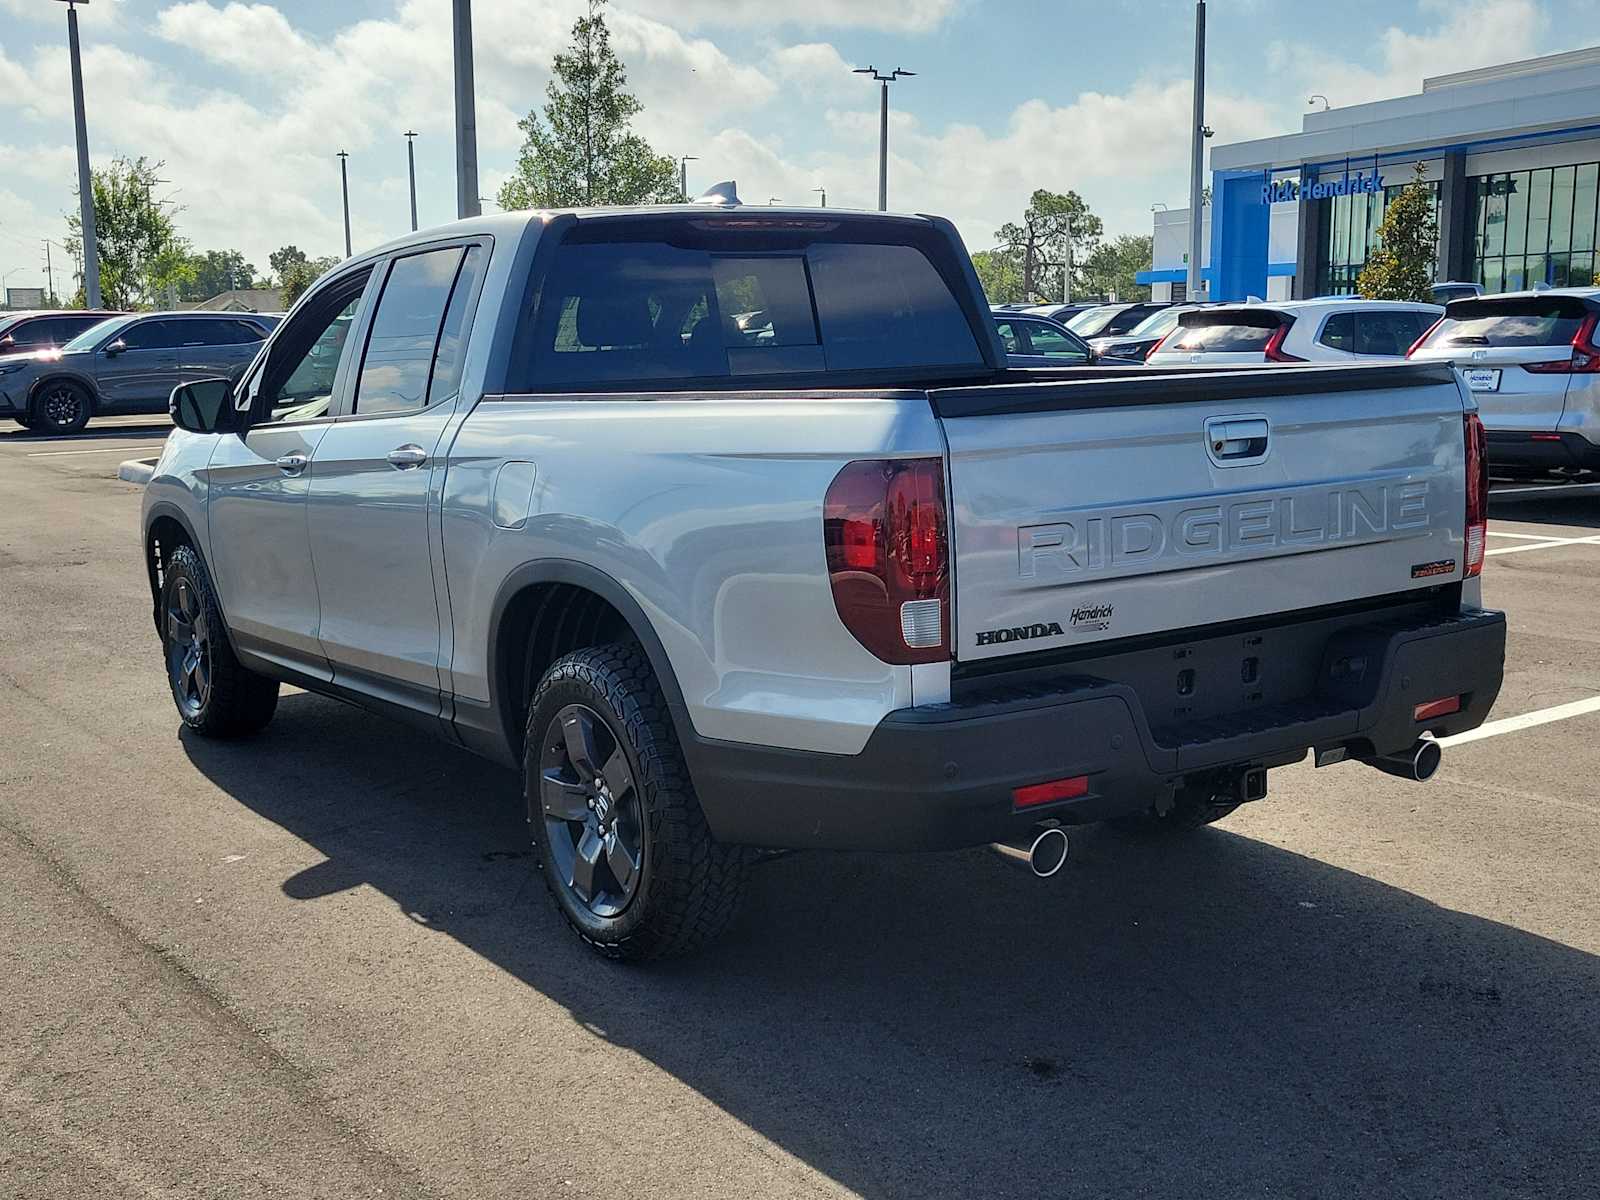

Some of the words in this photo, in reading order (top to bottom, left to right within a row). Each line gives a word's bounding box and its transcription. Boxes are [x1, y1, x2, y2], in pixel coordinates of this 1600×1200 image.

[1260, 179, 1296, 204] Rick
[1300, 167, 1384, 200] Hendrick
[1017, 481, 1430, 578] RIDGELINE
[1069, 603, 1114, 626] Hendrick
[975, 622, 1065, 646] HONDA
